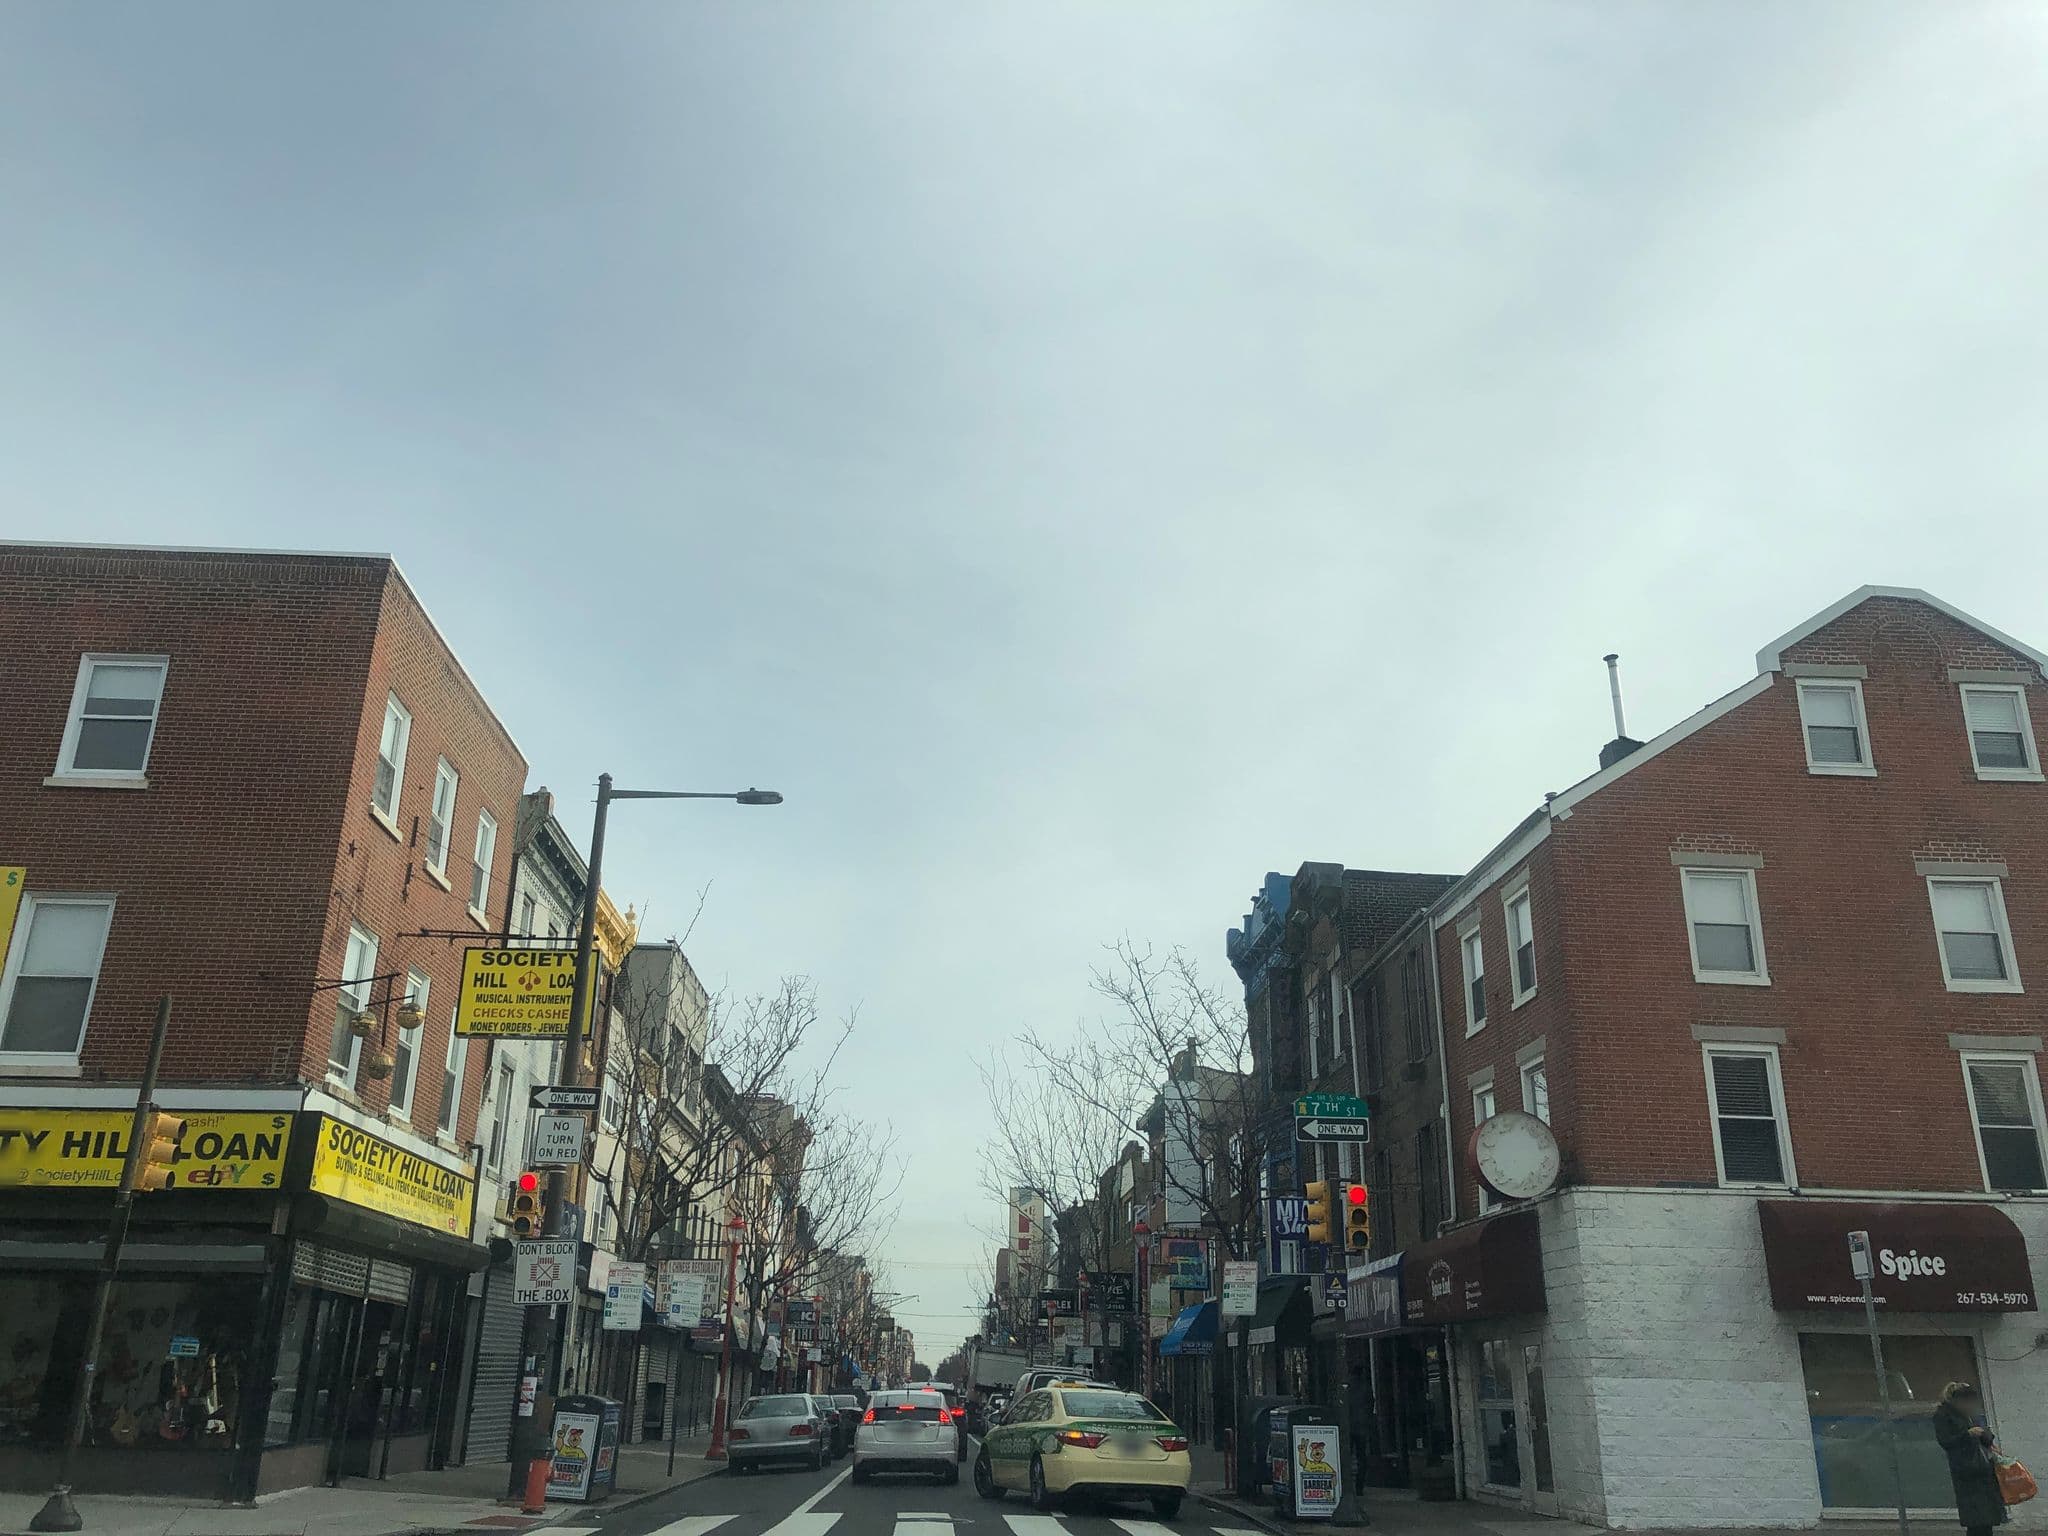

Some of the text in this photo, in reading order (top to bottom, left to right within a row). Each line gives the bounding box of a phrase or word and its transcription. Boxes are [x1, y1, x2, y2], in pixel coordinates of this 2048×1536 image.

[480, 951, 578, 967] SOCIETY
[473, 972, 576, 989] HILL LOA
[475, 993, 572, 1005] MUSICAL INSTRUMENT
[473, 1007, 569, 1020] CHECKS CASHE
[469, 1021, 499, 1032] MONEY
[500, 1022, 532, 1033] ORDERS
[538, 1022, 569, 1033] JEWELR
[550, 1093, 593, 1104] ONE WAY
[1345, 1106, 1357, 1117] ST
[552, 1122, 570, 1131] NO
[1317, 1125, 1360, 1135] ONE WAY
[61, 1130, 129, 1159] HIL
[546, 1134, 574, 1145] TURN
[538, 1147, 578, 1159] ON RED
[329, 1123, 399, 1174] SOCIETY
[399, 1153, 430, 1188] HILL
[432, 1168, 466, 1201] LOAN
[335, 1156, 358, 1177] BUYING
[358, 1168, 363, 1178] &
[363, 1166, 385, 1187] SELLING
[384, 1175, 395, 1192] ALL
[394, 1179, 410, 1196] ITEMS
[410, 1185, 418, 1197] OF
[417, 1187, 432, 1204] VALUE
[545, 1242, 574, 1256] BLOCK
[1879, 1248, 1947, 1282] Spice
[516, 1289, 570, 1302] THE BOX
[1806, 1292, 2029, 1305] www.spiceendcom 267-534-5970
